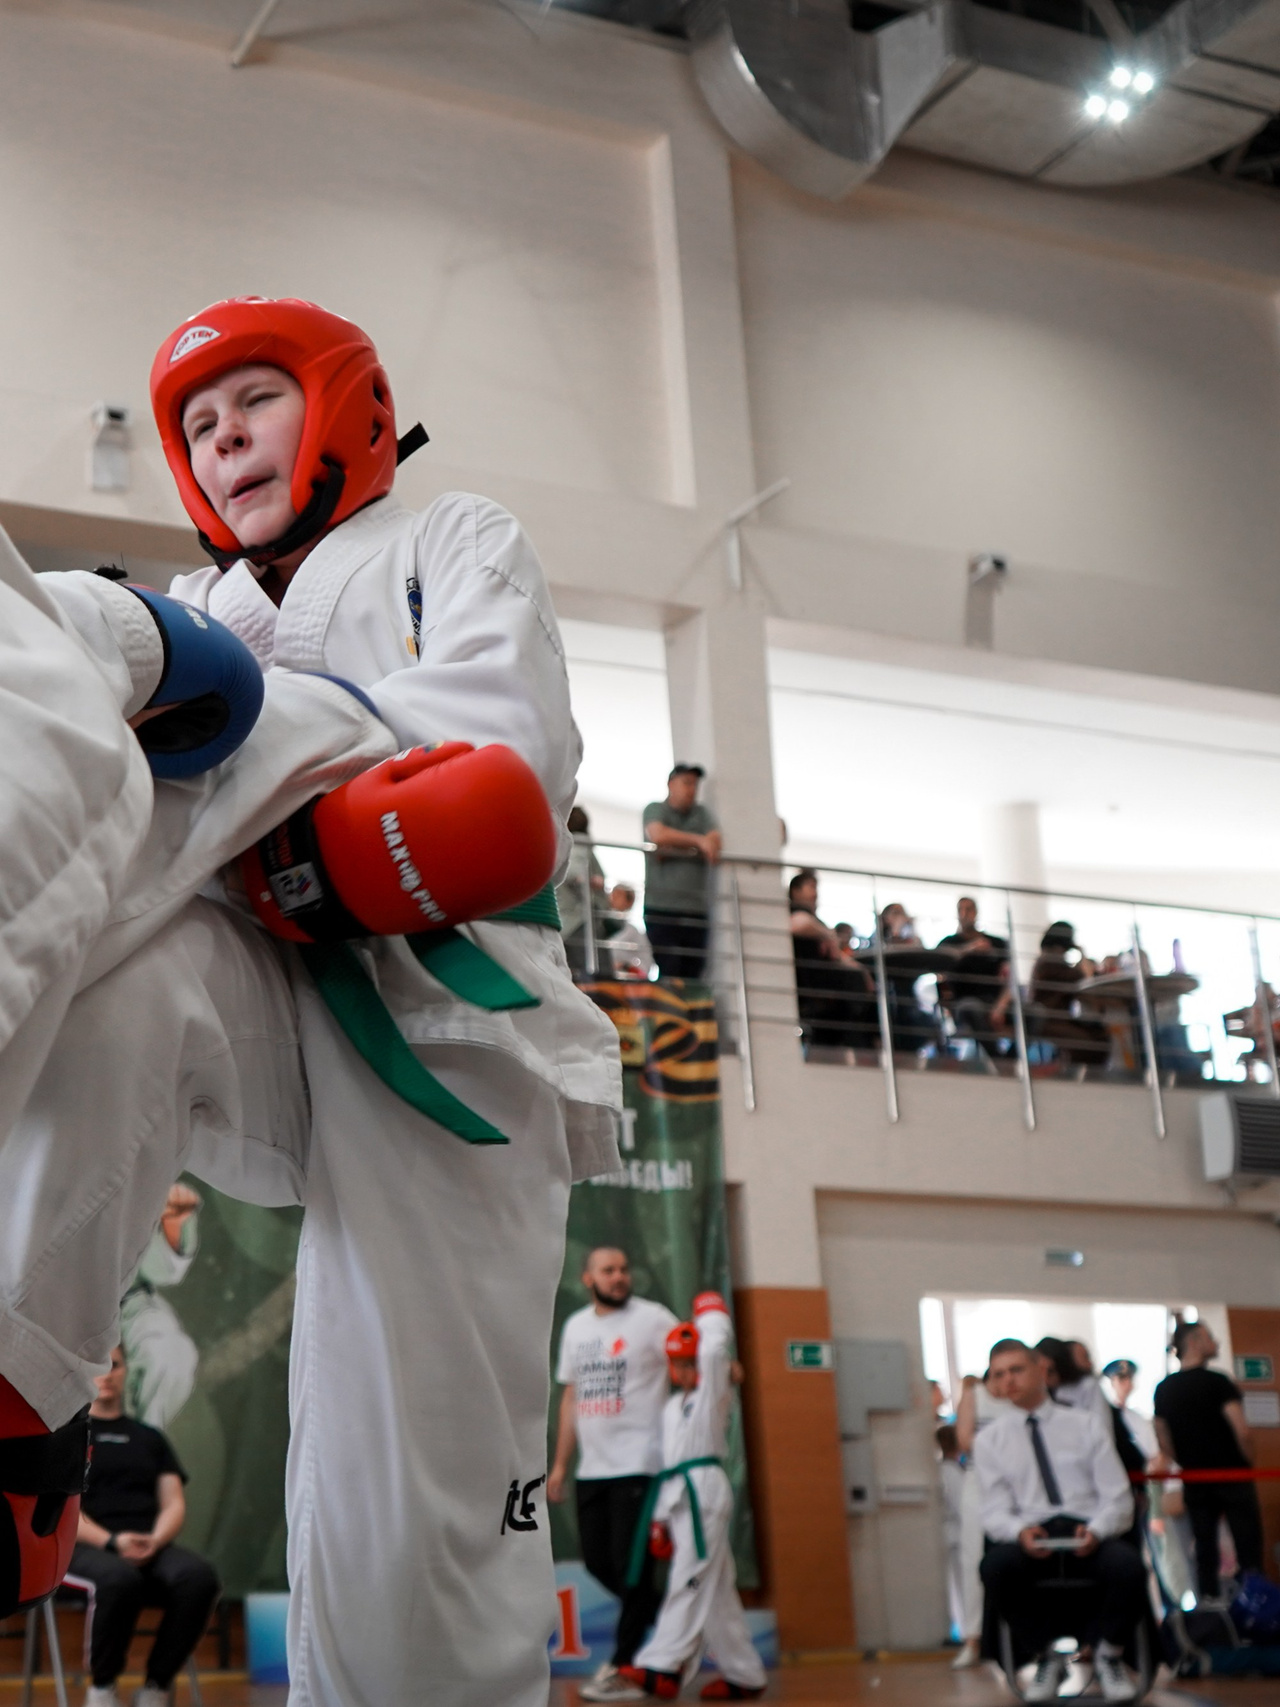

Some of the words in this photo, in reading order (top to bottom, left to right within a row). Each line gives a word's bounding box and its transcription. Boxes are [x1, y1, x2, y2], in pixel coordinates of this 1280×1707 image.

[191, 330, 214, 339] TEN
[380, 810, 410, 864] MAX
[411, 888, 447, 922] PRO
[552, 1585, 590, 1660] 1
